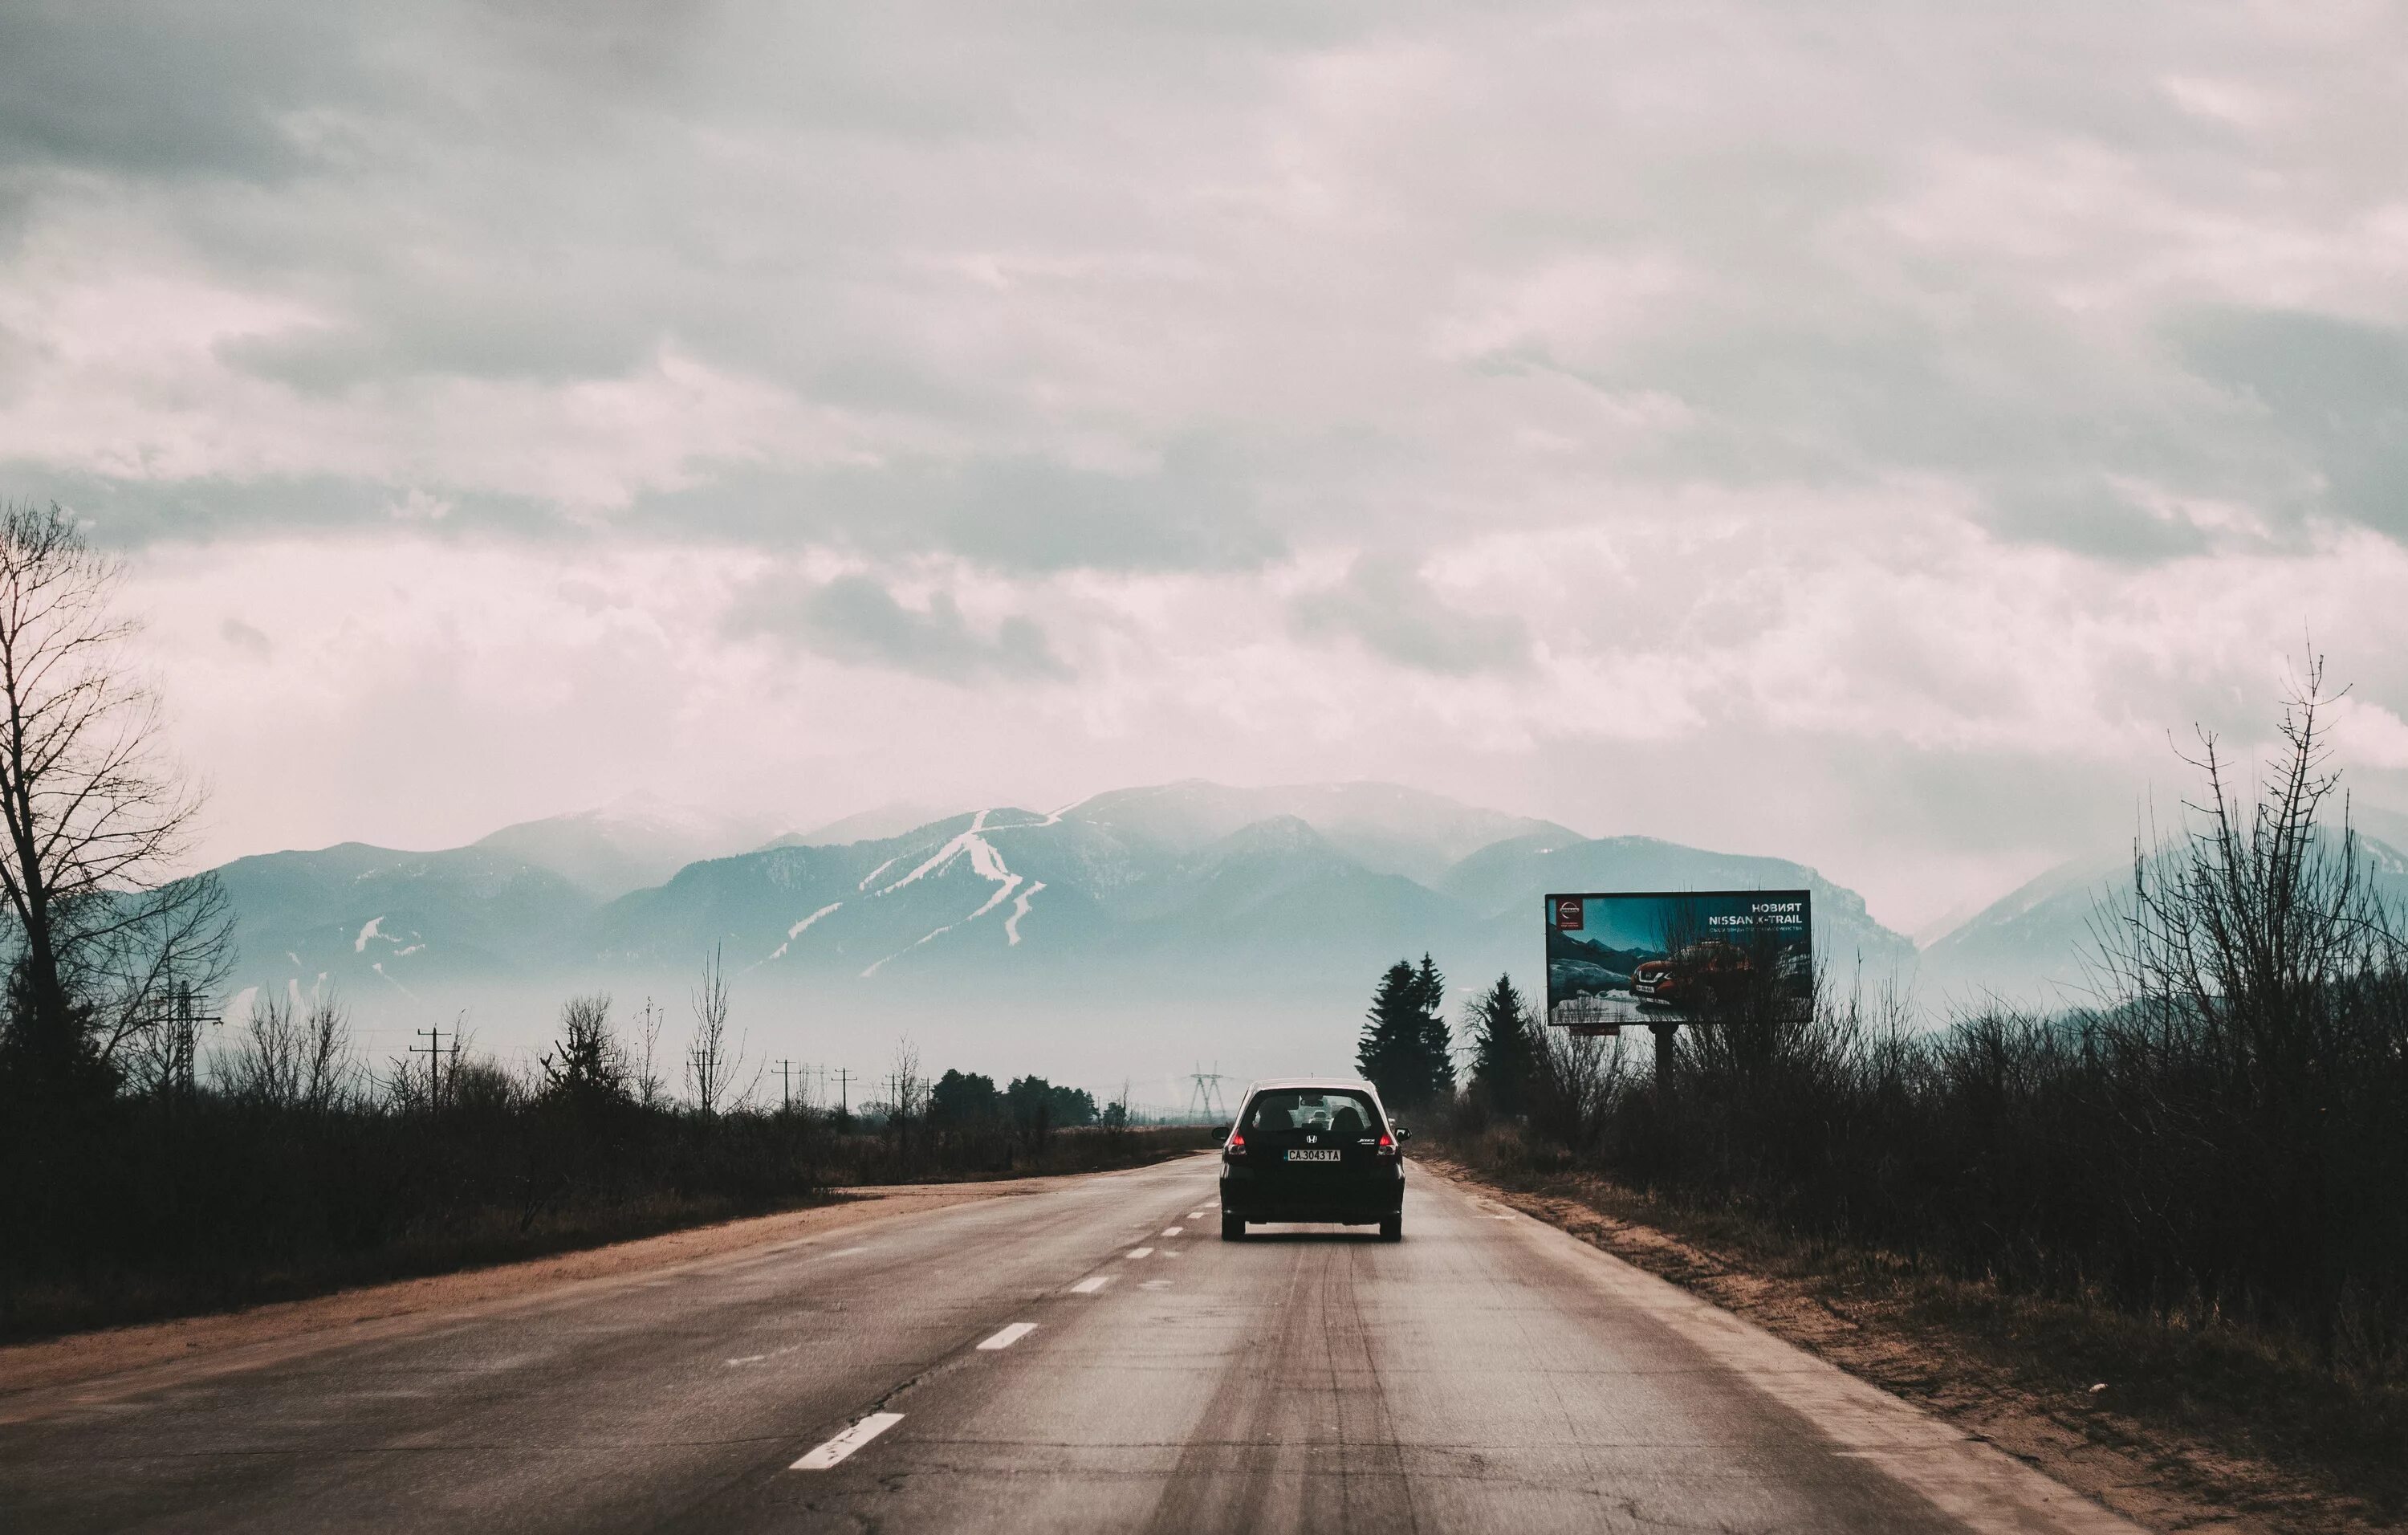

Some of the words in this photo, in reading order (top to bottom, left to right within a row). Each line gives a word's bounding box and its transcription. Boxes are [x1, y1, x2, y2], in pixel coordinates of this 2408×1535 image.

[1751, 903, 1802, 913] НОВИЯТ
[1709, 916, 1753, 925] NISSAN
[1289, 1150, 1302, 1160] CA
[1303, 1150, 1325, 1160] 3043
[1327, 1150, 1339, 1160] TA
